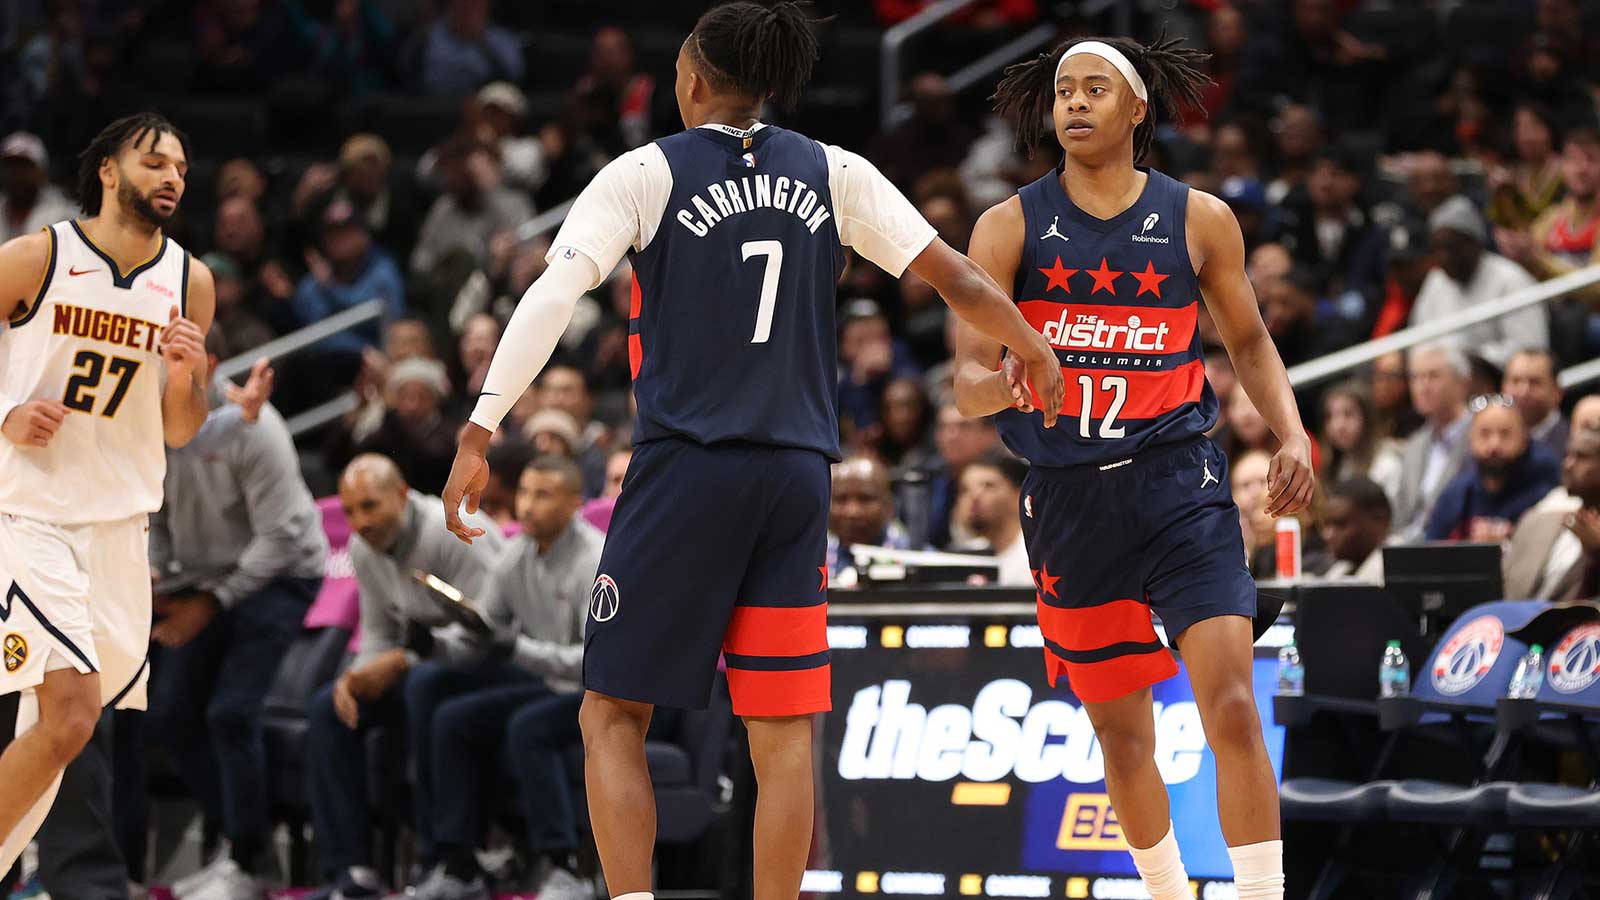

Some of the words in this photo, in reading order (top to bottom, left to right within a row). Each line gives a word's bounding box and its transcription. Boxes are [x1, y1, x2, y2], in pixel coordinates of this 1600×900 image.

[676, 174, 831, 238] CARRINGTON
[1131, 234, 1169, 244] Robinhood
[741, 240, 784, 343] 7
[1043, 308, 1169, 351] district
[1076, 314, 1098, 324] THE
[63, 351, 142, 418] 27
[1066, 354, 1163, 367] COLUMBIA
[1078, 375, 1127, 439] 12
[838, 679, 1206, 785] theScoe
[1072, 804, 1121, 839] BE
